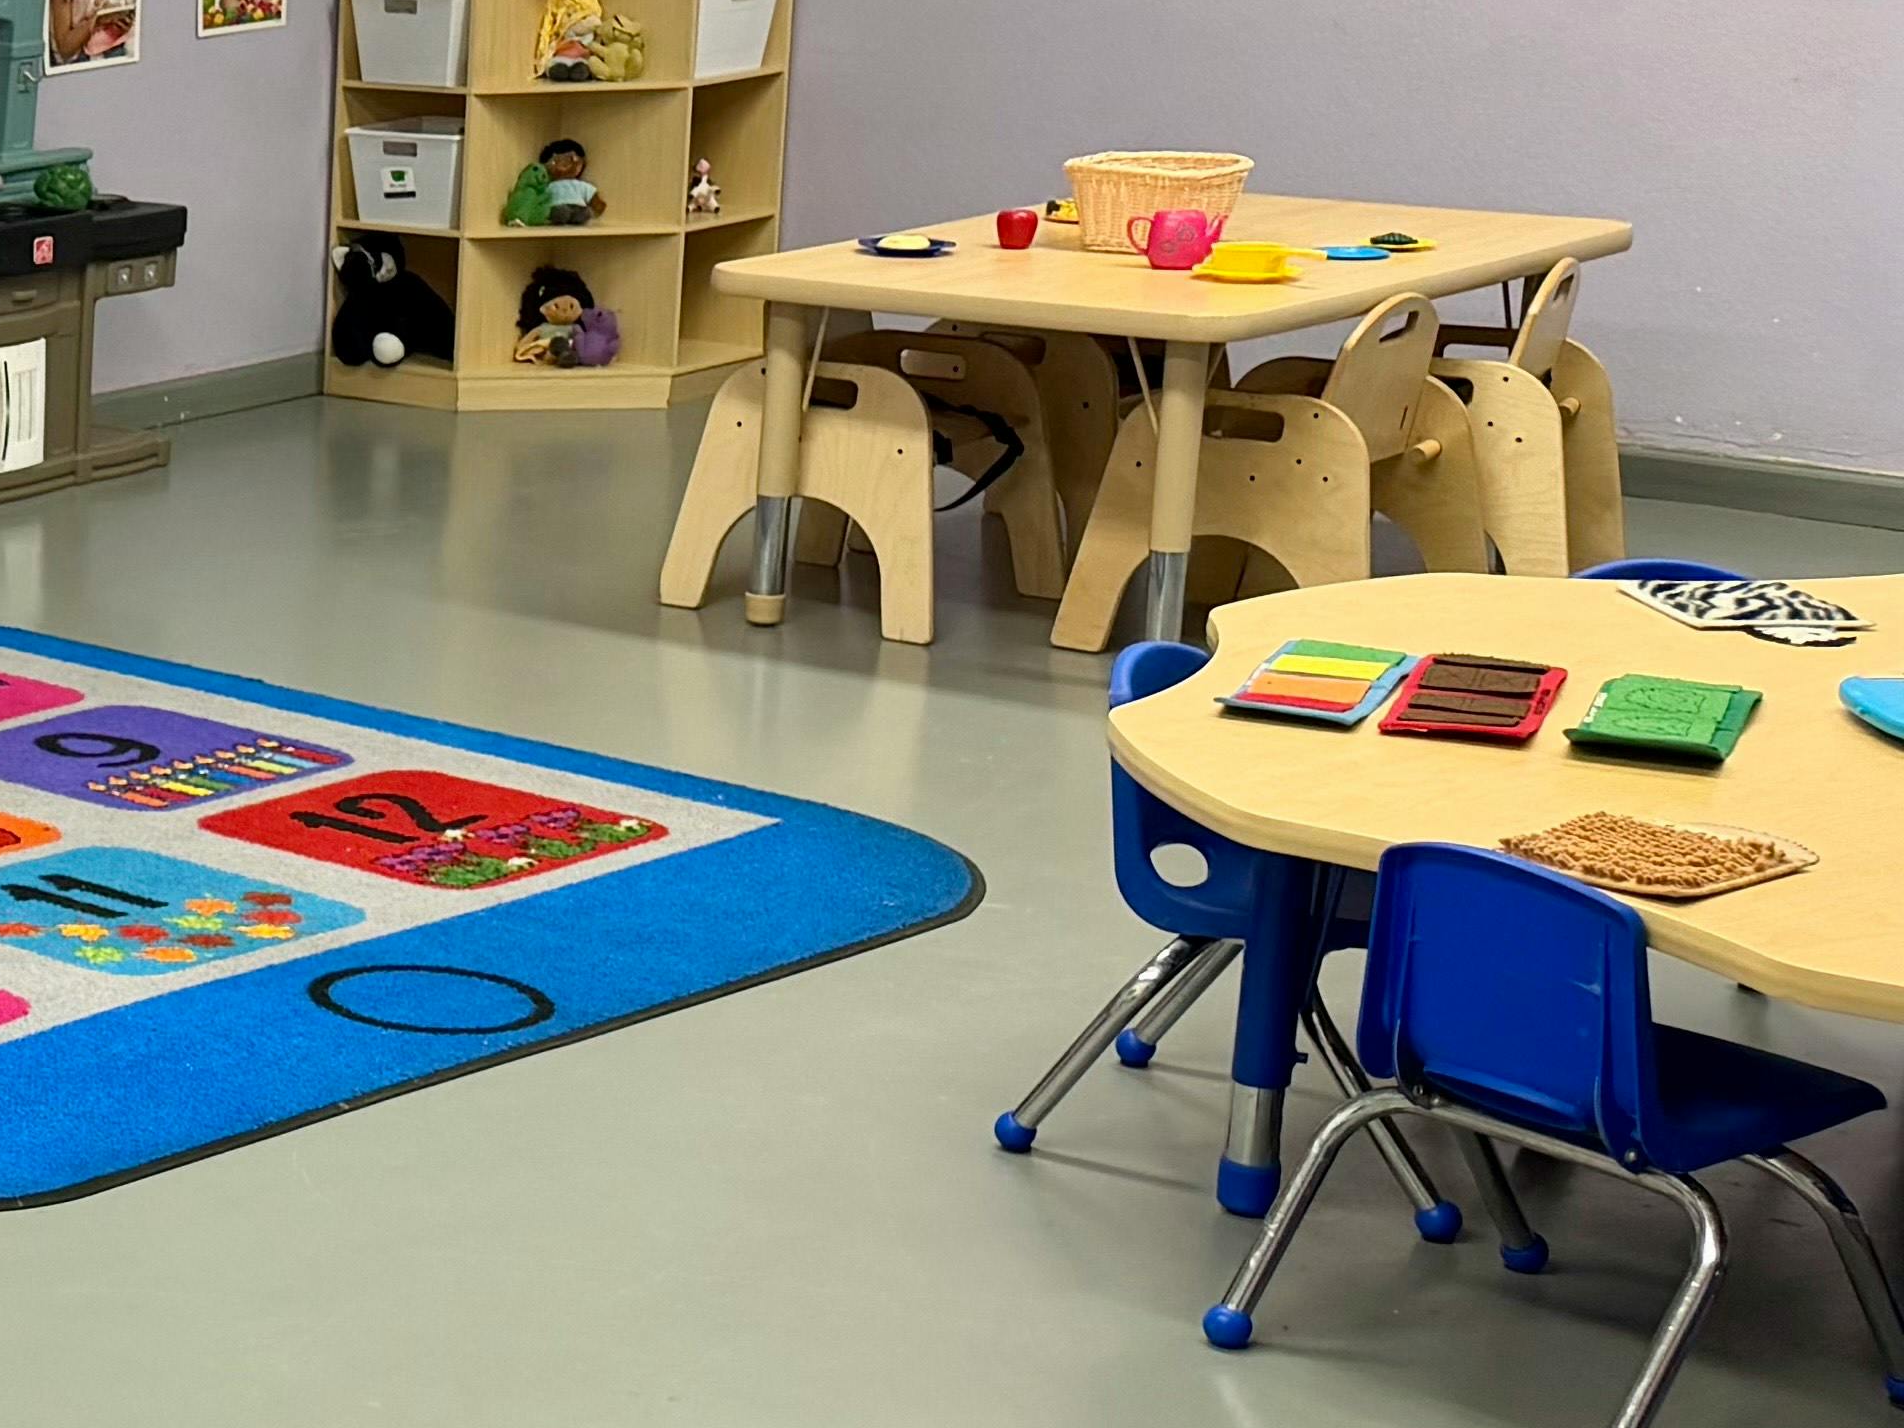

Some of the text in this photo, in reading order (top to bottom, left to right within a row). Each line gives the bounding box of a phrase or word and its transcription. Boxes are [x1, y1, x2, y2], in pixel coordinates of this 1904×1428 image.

[33, 730, 162, 769] 9
[288, 792, 492, 845] 12
[0, 872, 170, 919] 11
